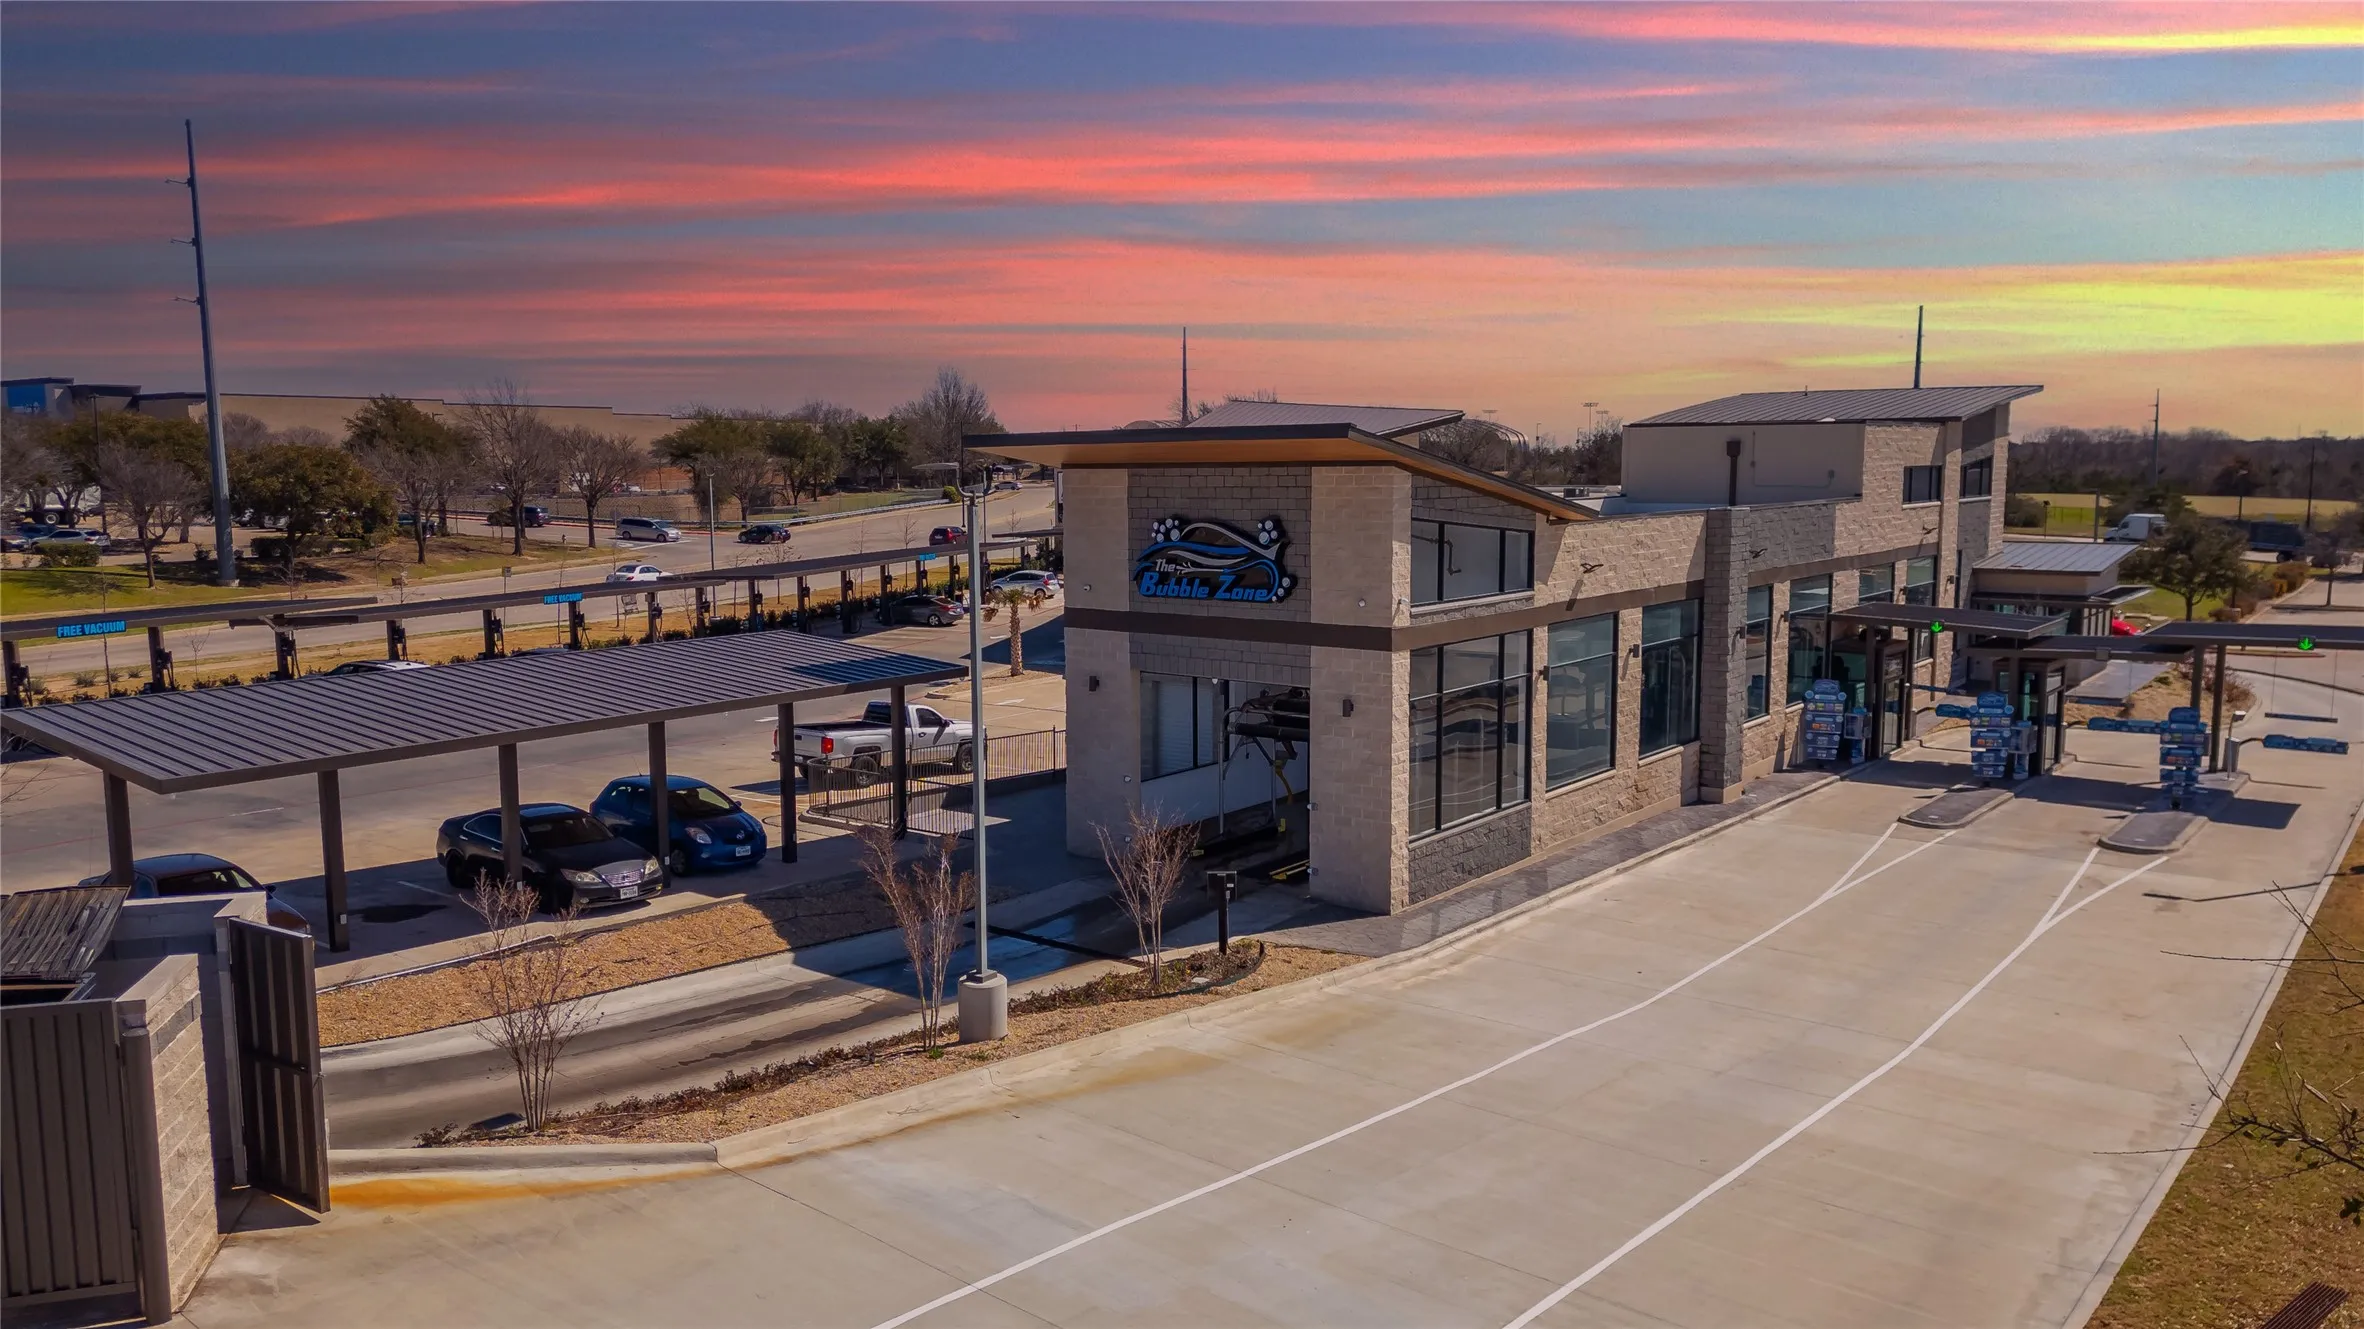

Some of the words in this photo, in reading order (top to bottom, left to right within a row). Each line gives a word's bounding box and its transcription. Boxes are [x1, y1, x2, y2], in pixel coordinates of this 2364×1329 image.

[1156, 559, 1175, 572] The
[1140, 572, 1209, 598] Bubble
[1214, 575, 1268, 601] Zone
[57, 625, 82, 637] FREE
[84, 620, 125, 635] VACUUM
